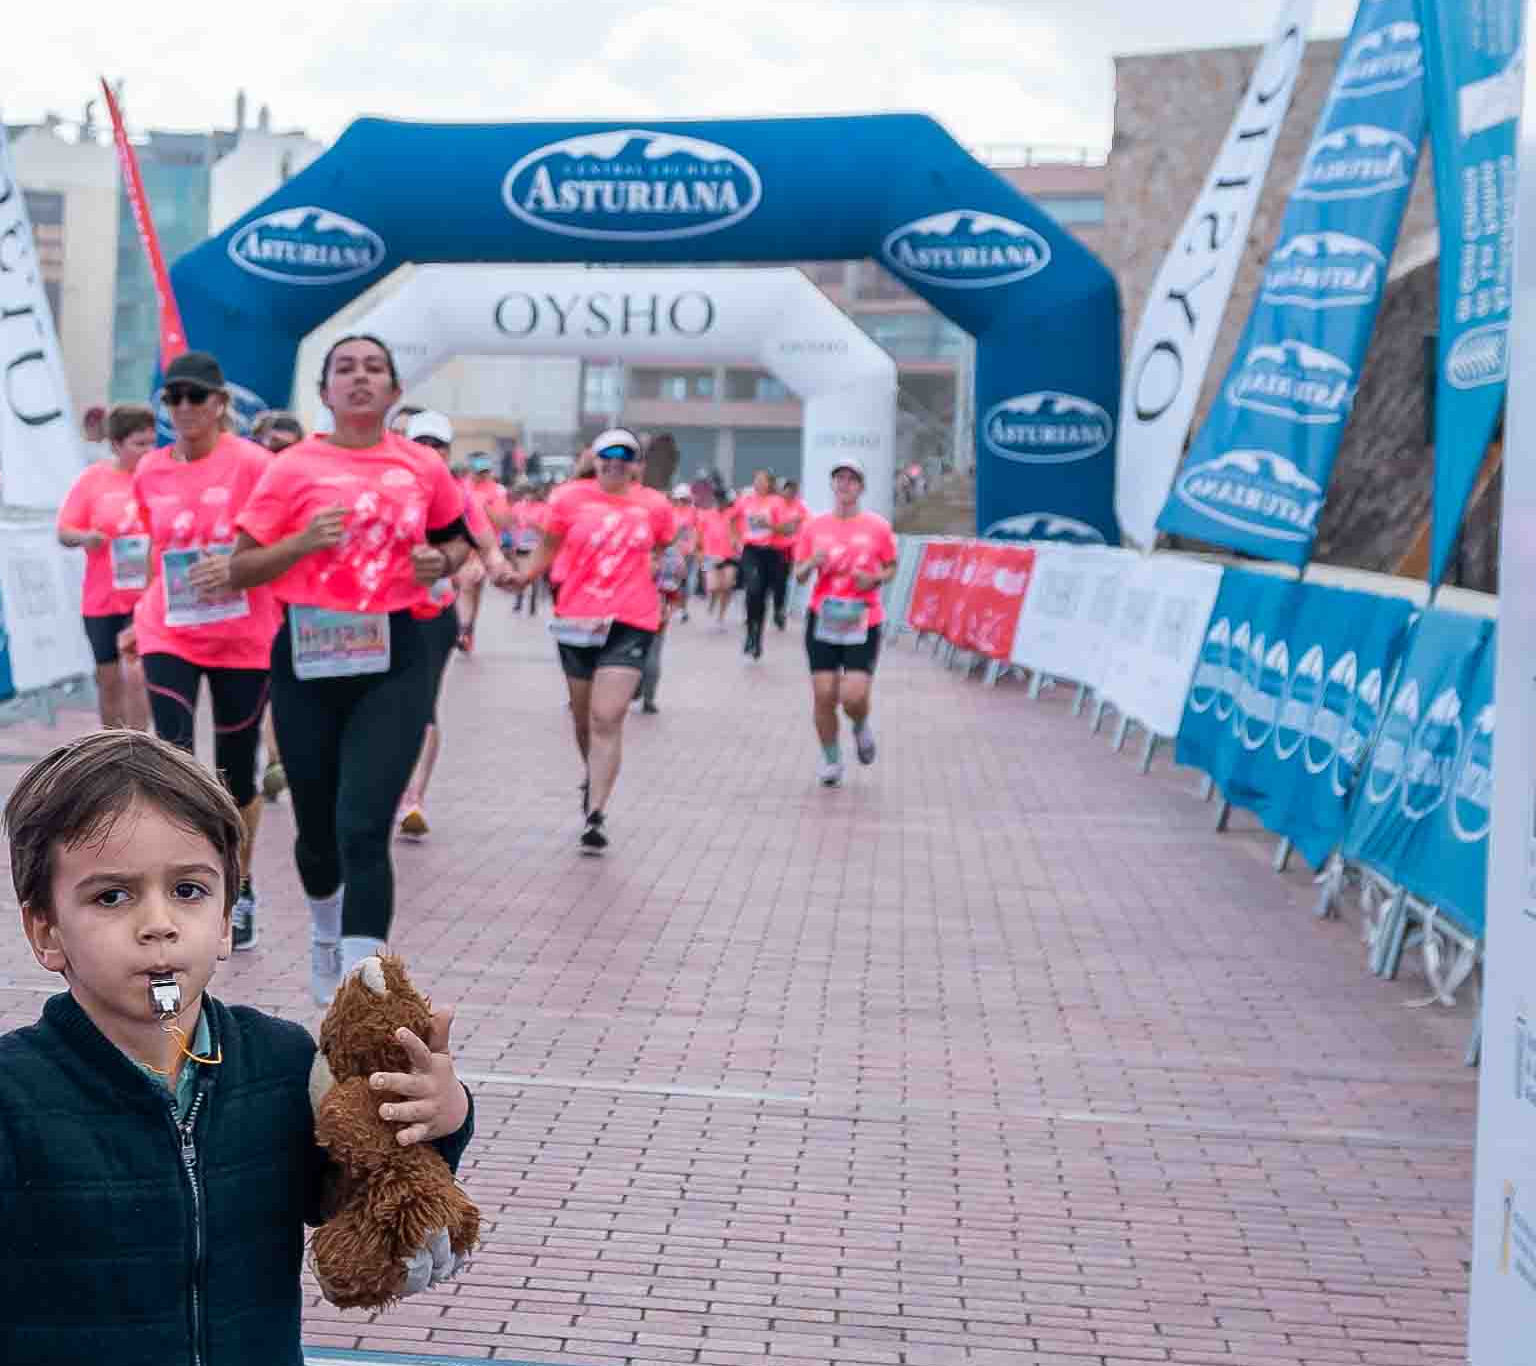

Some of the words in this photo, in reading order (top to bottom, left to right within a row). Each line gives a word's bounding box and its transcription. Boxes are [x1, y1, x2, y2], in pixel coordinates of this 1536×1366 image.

[524, 165, 742, 213] ASTURIANA
[234, 238, 377, 269] ASTURIANA
[888, 238, 1044, 269] ASTURIANA
[494, 291, 716, 337] OYSHO
[987, 418, 1105, 449] ASTURIANA
